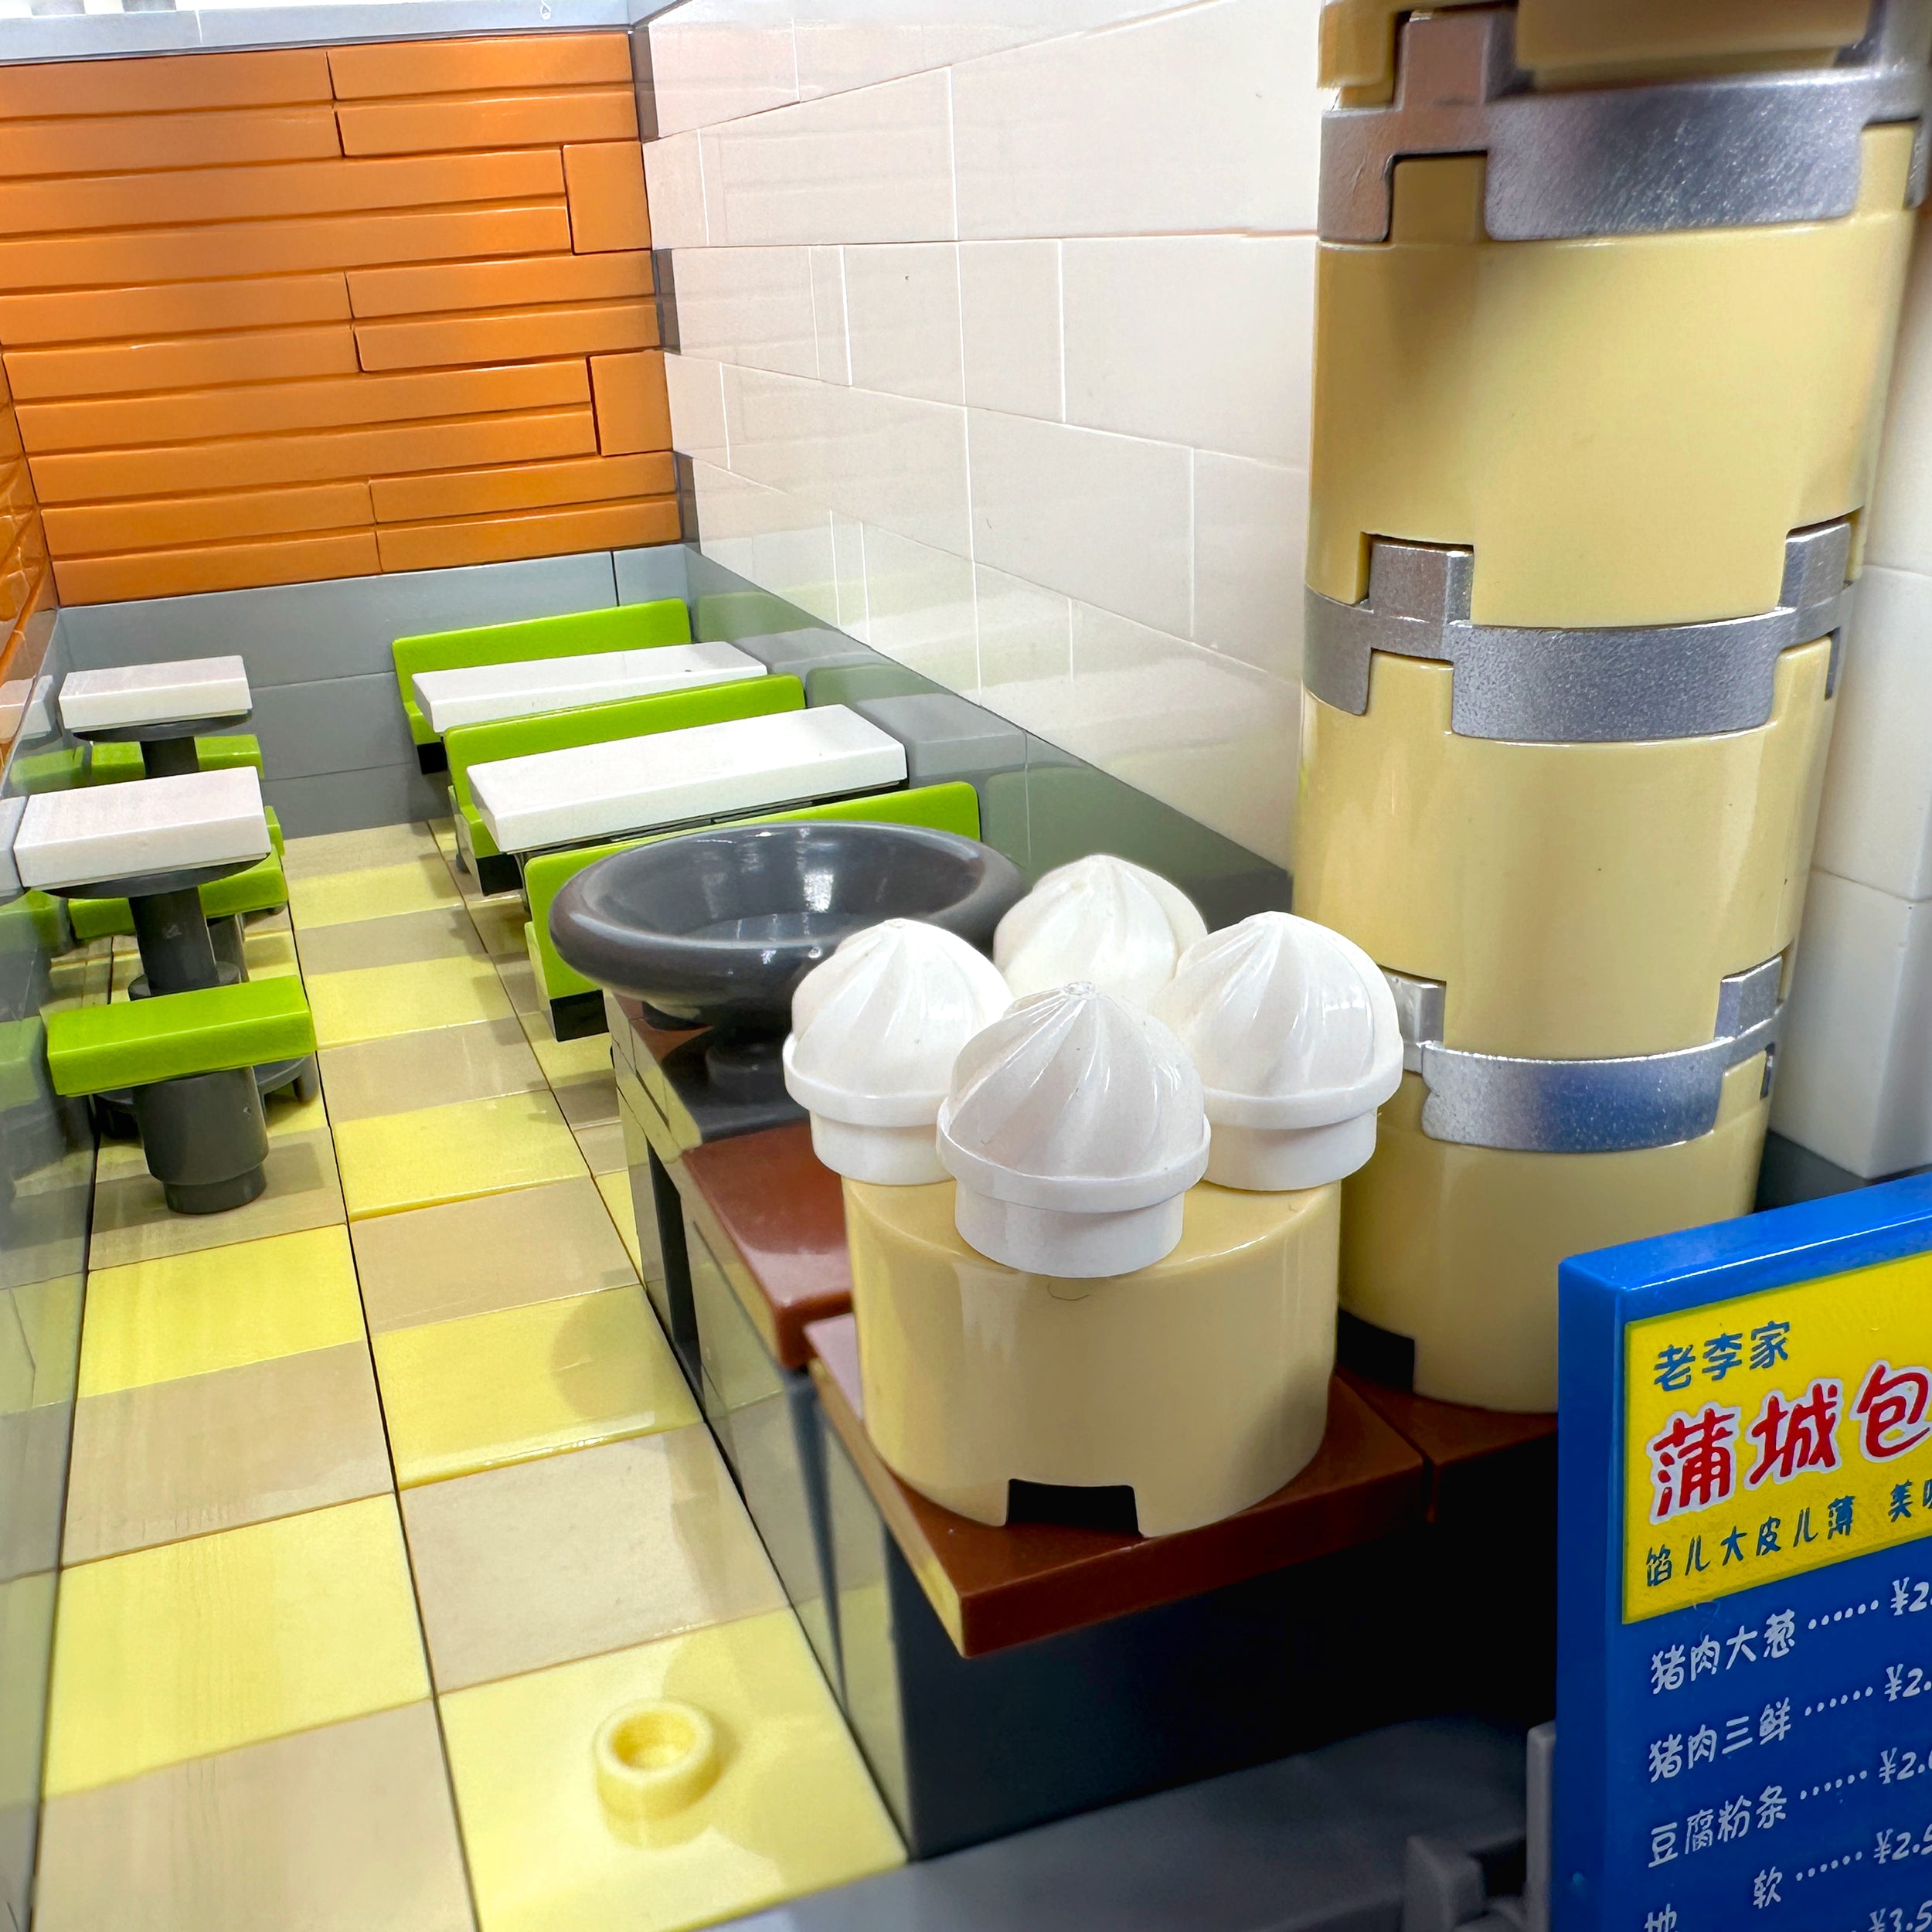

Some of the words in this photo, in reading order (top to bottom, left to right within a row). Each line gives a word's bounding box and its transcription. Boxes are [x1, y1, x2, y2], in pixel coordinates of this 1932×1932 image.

[1653, 1320, 1791, 1393] 老李家
[1651, 1362, 1931, 1519] 蒲城包
[1645, 1495, 1855, 1587] 馅儿大皮儿薄
[1650, 1607, 1796, 1695] 猪肉大葱
[1889, 1576, 1932, 1616] ¥2
[1648, 1696, 1792, 1784] 猪肉三鲜
[1647, 1784, 1787, 1869] 豆腐粉条
[1878, 1747, 1932, 1785] ¥2.
